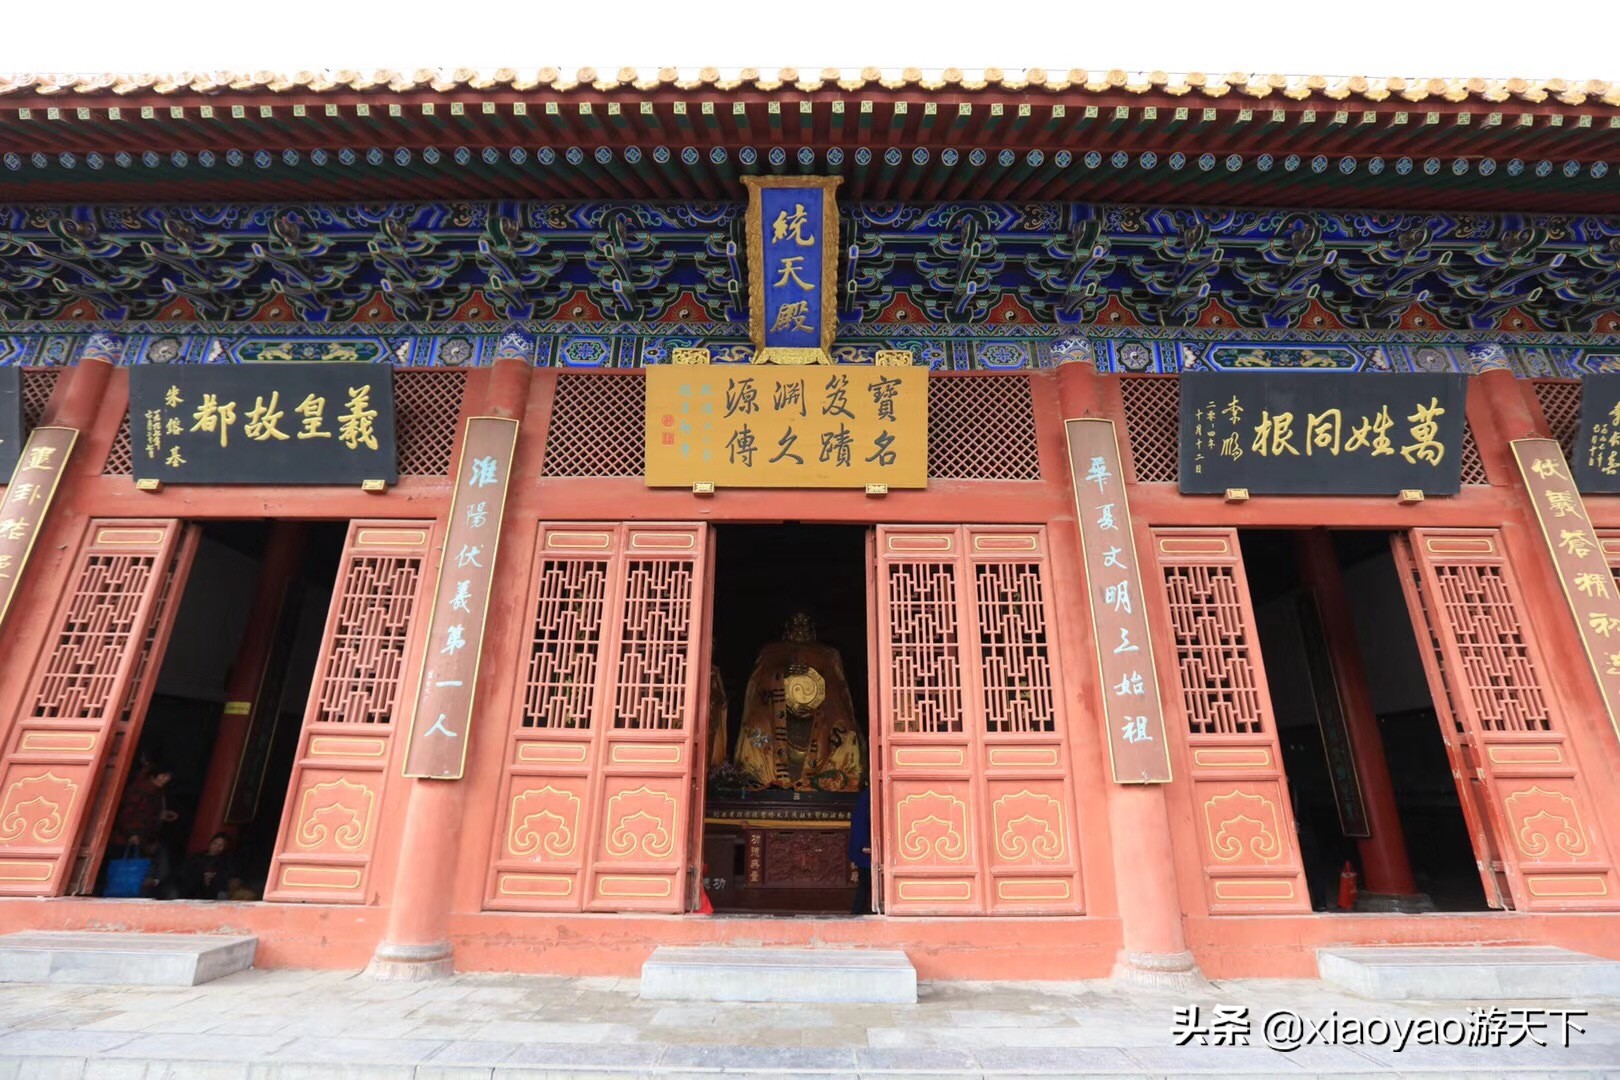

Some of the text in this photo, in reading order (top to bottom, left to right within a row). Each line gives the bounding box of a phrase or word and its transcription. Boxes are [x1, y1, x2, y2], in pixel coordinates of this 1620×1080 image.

[769, 203, 815, 334] 統天殿
[1251, 396, 1446, 466] 萬姓同根
[1084, 456, 1153, 744] 華夏文明之始祖
